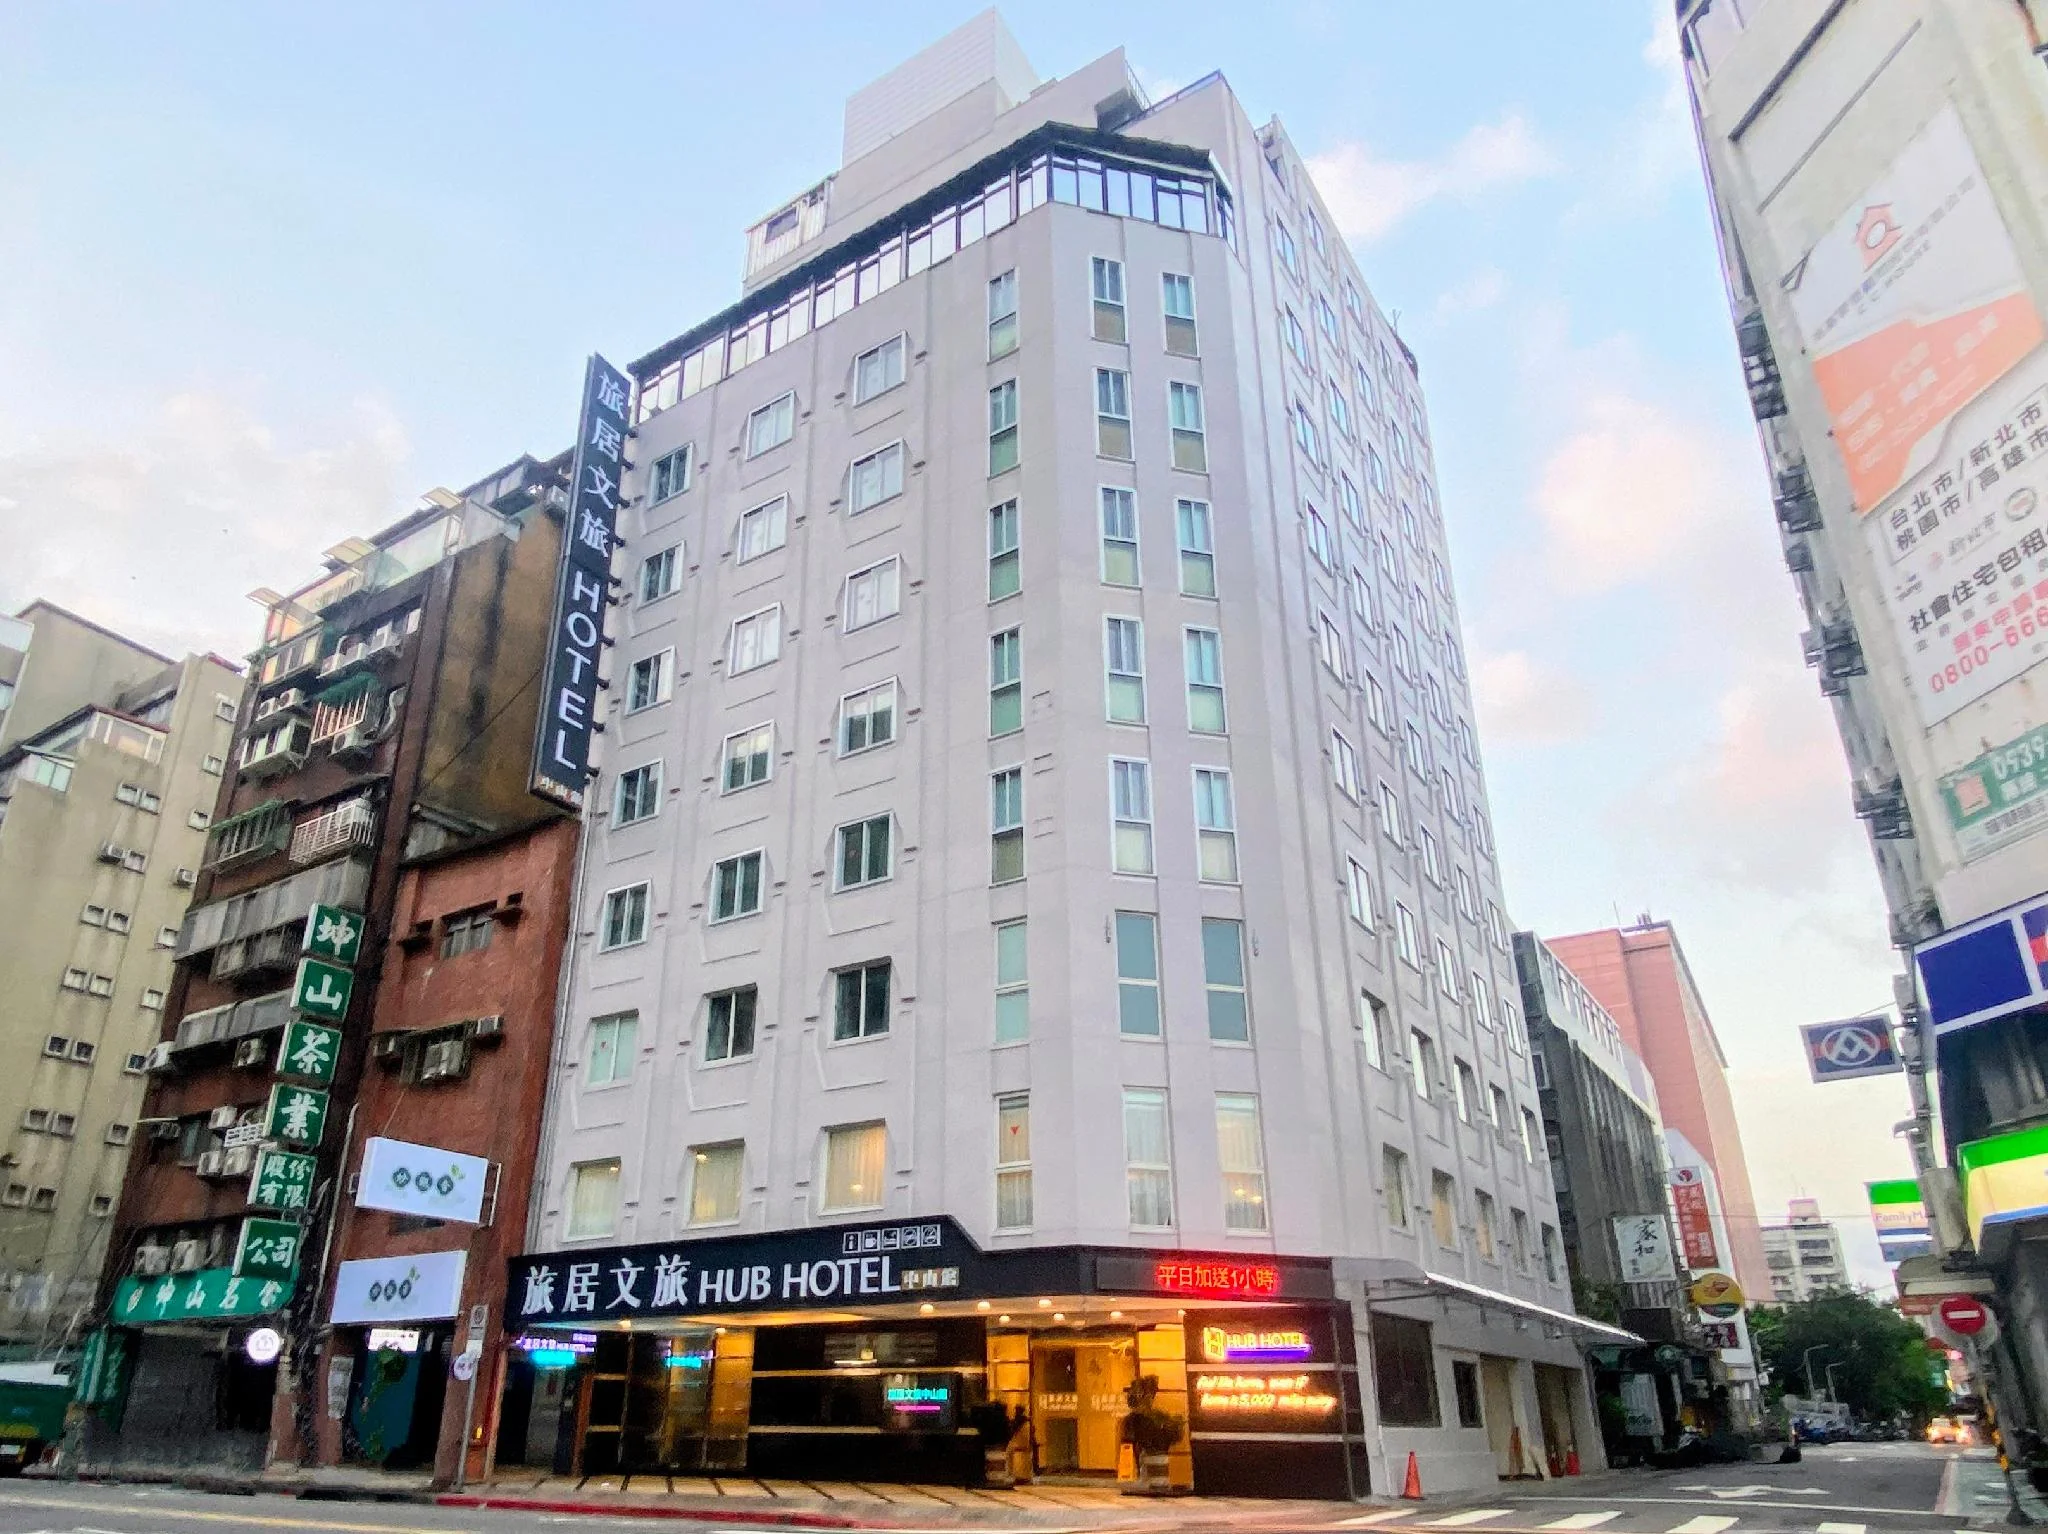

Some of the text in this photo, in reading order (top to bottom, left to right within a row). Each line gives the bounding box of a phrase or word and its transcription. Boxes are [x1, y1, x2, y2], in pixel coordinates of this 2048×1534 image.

[579, 371, 626, 559] 旅居文旅
[1908, 524, 2048, 635] 社會住宅包租
[555, 570, 600, 770] HOTEL
[1875, 1208, 1926, 1224] FamilyM
[246, 1236, 297, 1269] 公司
[520, 1253, 692, 1316] 旅居文旅
[698, 1265, 771, 1305] HUB
[782, 1255, 901, 1298] HOTEL
[1157, 1264, 1276, 1292] 平日加送1小時
[1226, 1333, 1256, 1347] HUB
